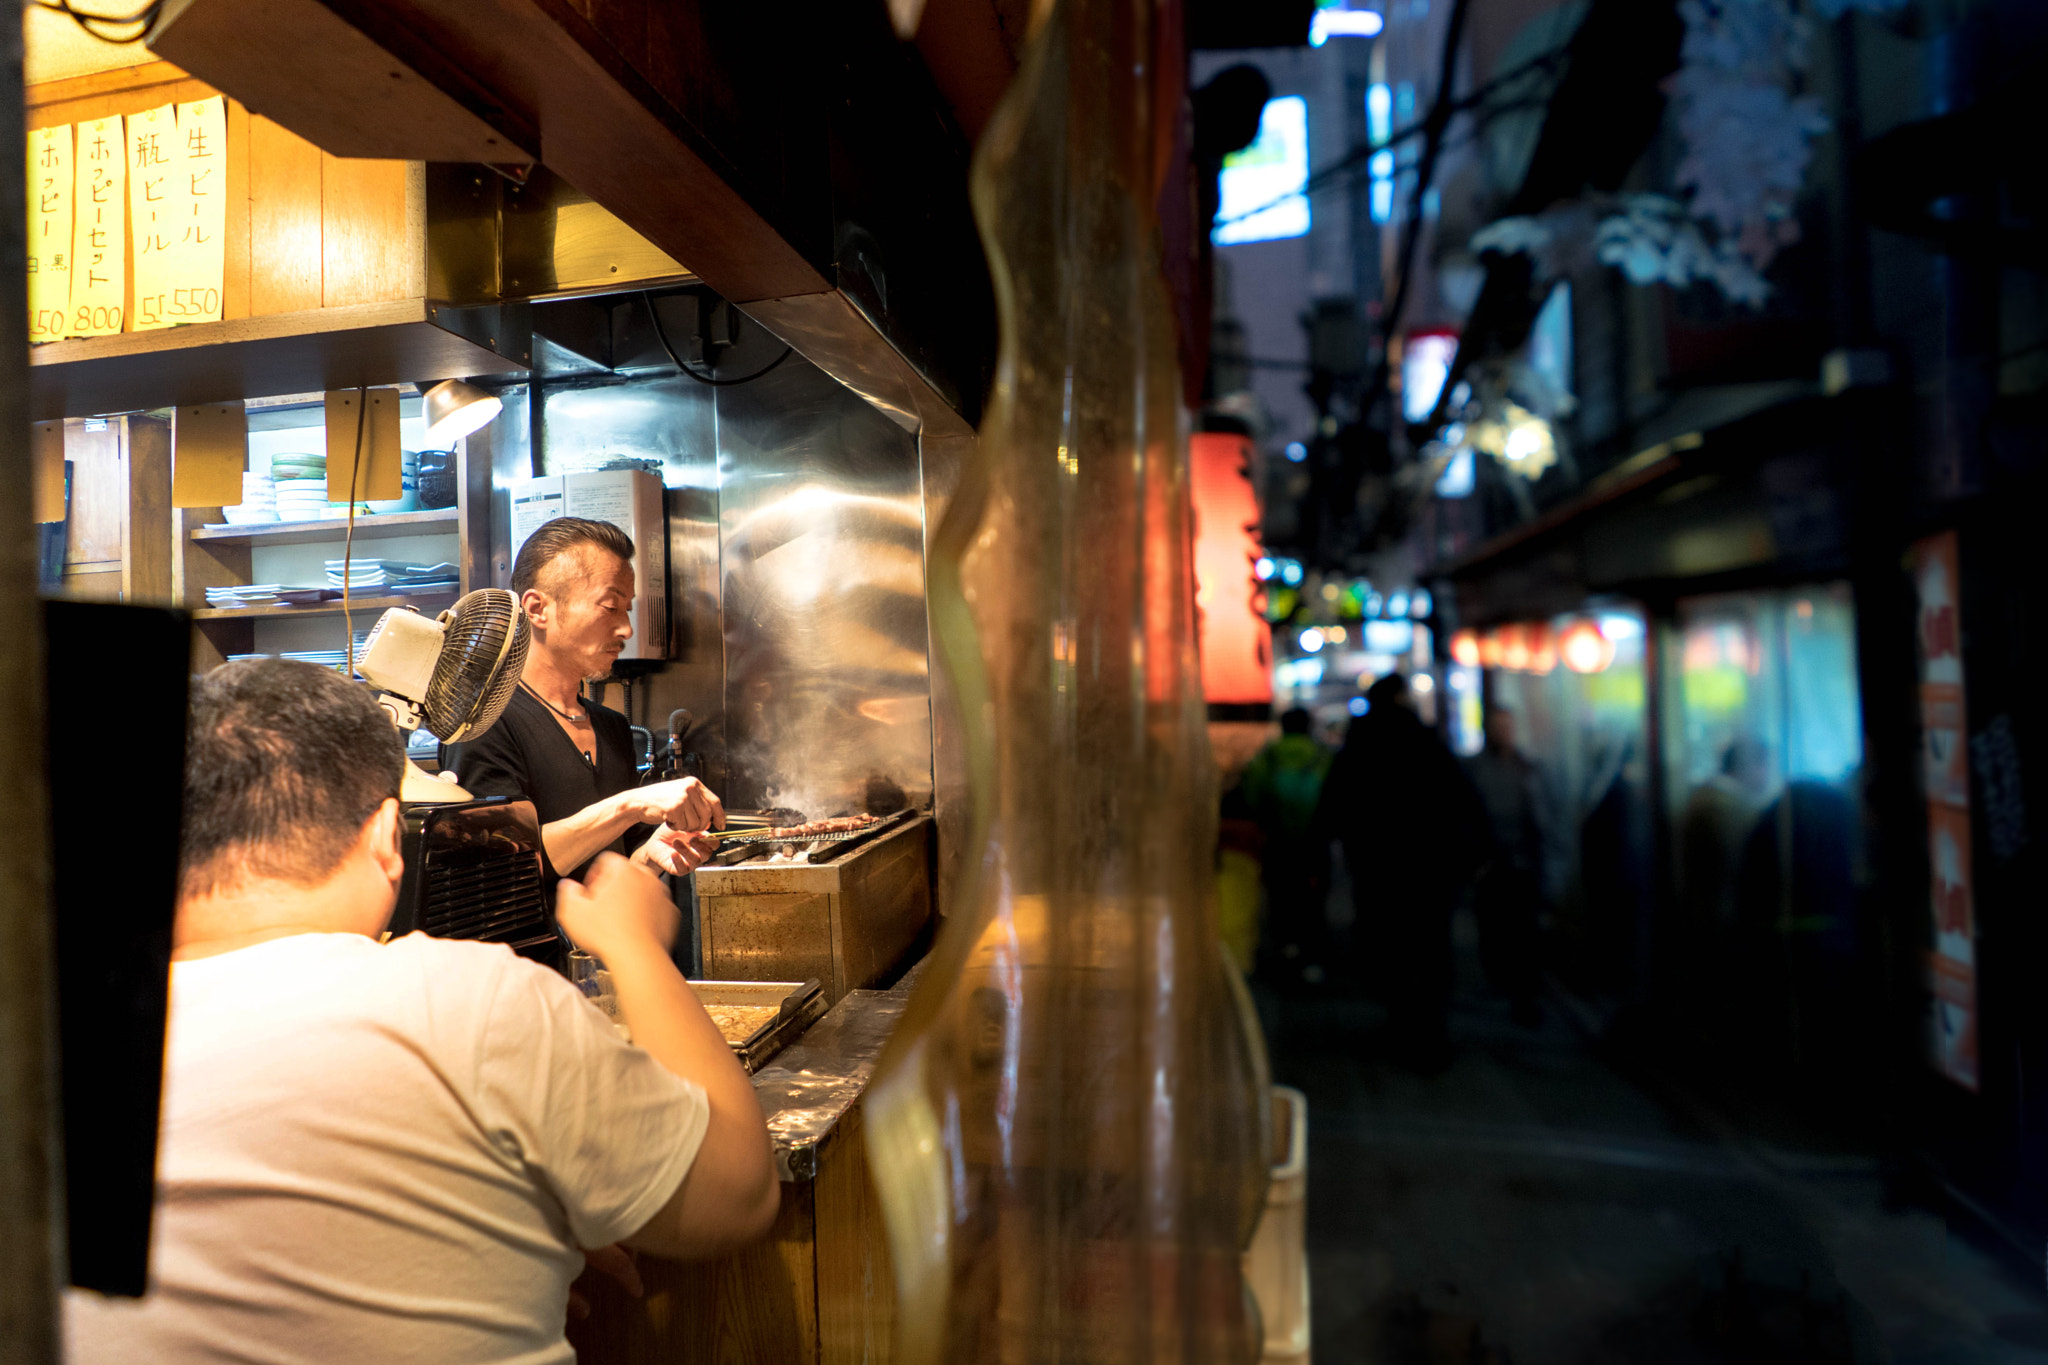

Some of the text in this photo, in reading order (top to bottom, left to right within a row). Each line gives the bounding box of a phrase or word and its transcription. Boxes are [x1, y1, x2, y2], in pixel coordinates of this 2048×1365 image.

[41, 144, 59, 237] ホッピー
[88, 136, 112, 288] ホッピーセット
[136, 133, 171, 254] 瓶ビール
[182, 127, 213, 243] 生ビール
[28, 310, 64, 335] 50
[74, 306, 121, 331] 800
[167, 288, 219, 315] 550
